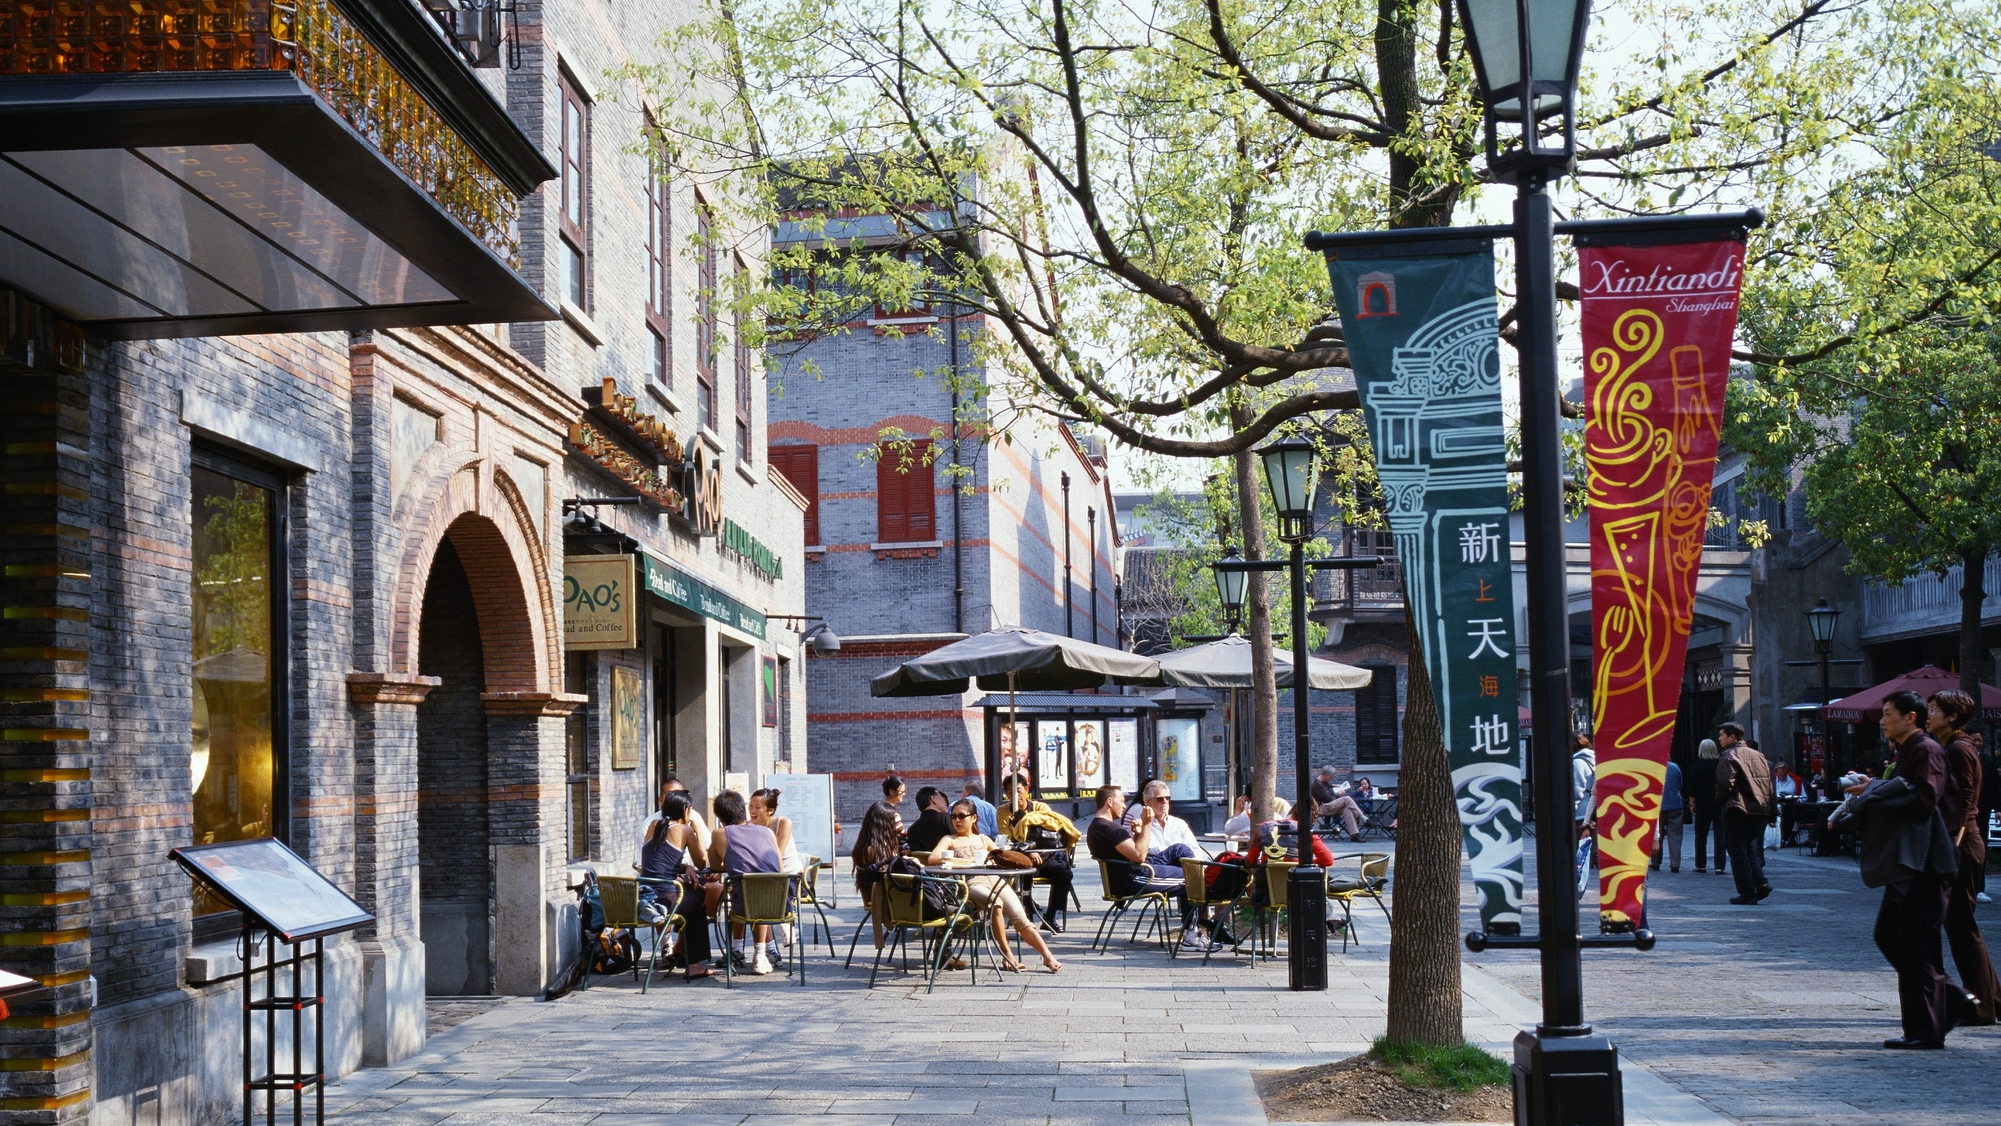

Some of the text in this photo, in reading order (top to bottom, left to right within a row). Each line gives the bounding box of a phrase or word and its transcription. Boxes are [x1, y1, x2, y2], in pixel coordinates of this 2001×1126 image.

[1583, 254, 1742, 294] Xintiandi
[1665, 295, 1737, 317] Shanghai
[578, 624, 594, 632] and
[595, 622, 623, 632] Coffee
